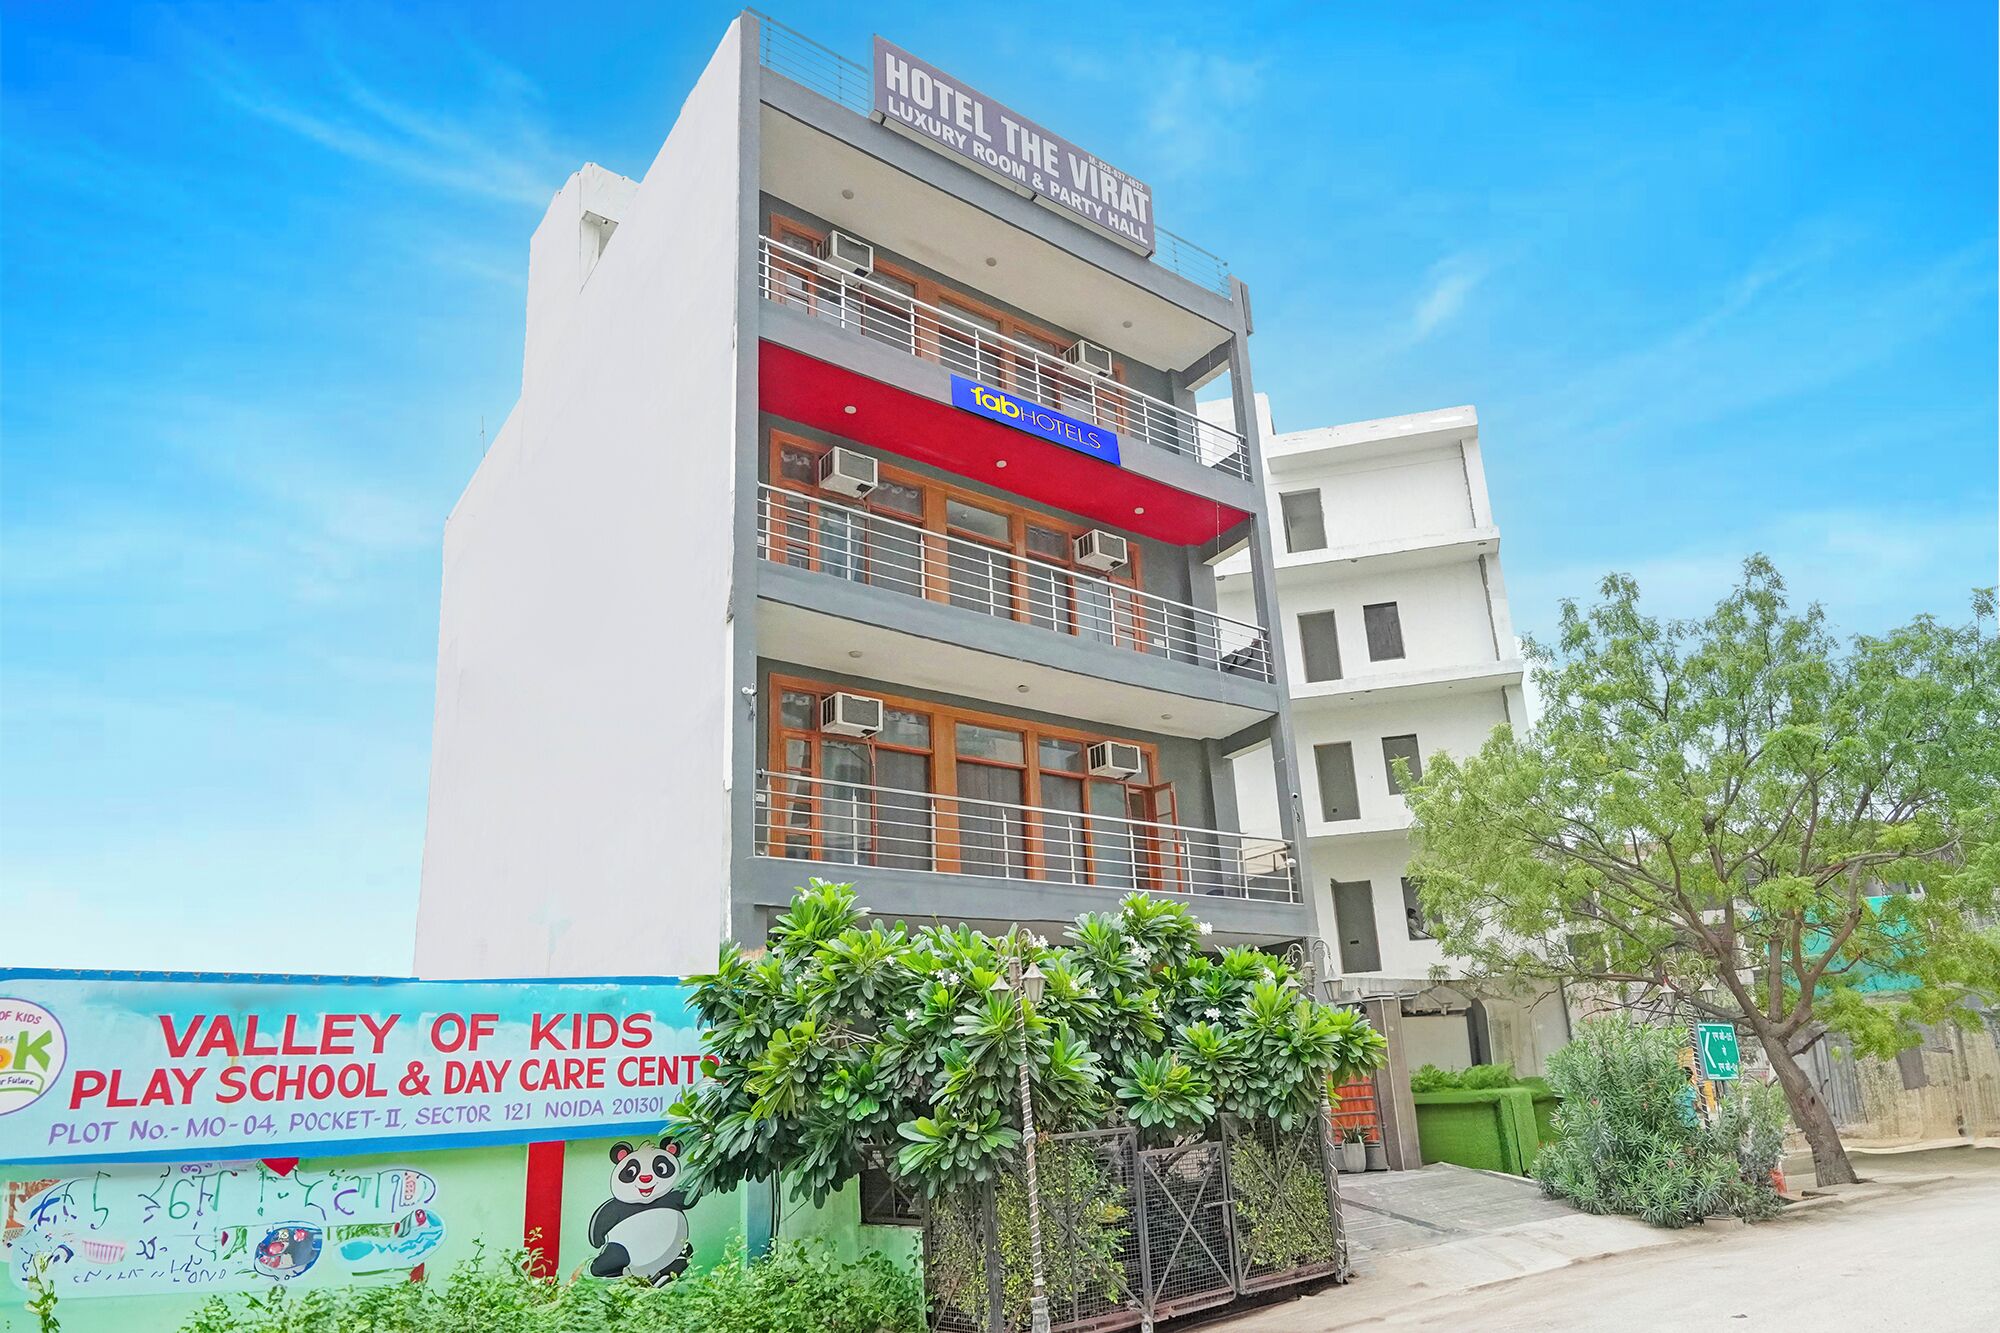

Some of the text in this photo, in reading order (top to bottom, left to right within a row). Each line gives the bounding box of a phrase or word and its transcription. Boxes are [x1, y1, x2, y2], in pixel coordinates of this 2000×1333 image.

[885, 52, 1149, 225] HOTEL THE VIRAT
[887, 95, 1148, 244] LUXURY ROOM & PARTY HALL
[970, 387, 1101, 449] fabHOTELS
[15, 1011, 42, 1024] KIDS
[158, 1013, 652, 1057] VALLEY OF KIDS
[7, 1076, 34, 1086] Future
[69, 1067, 207, 1109] PLAY
[215, 1063, 388, 1103] SCHOOL
[400, 1061, 431, 1096] &
[443, 1059, 512, 1094] DAY
[519, 1057, 606, 1092] CARE
[48, 1121, 118, 1146] PLOT
[415, 1104, 492, 1125] SECTOR
[504, 1102, 531, 1120] 121
[545, 1099, 604, 1118] NOIDA
[612, 1096, 664, 1115] 201301
